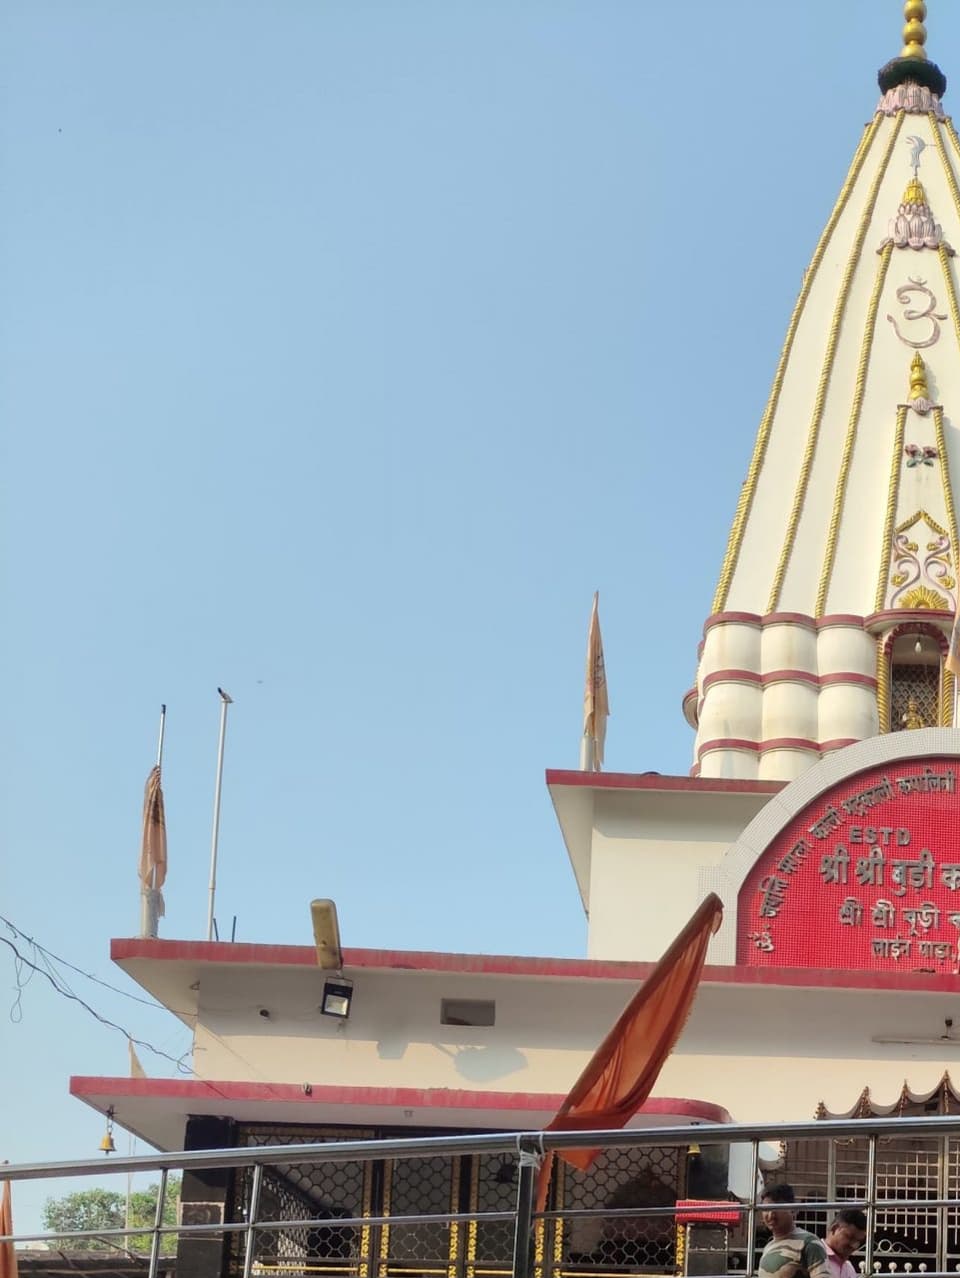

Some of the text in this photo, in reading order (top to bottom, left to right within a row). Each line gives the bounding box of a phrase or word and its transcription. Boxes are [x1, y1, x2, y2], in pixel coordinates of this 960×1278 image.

[849, 825, 912, 846] ESTD
[820, 842, 850, 885] श्री
[855, 844, 886, 886] श्री
